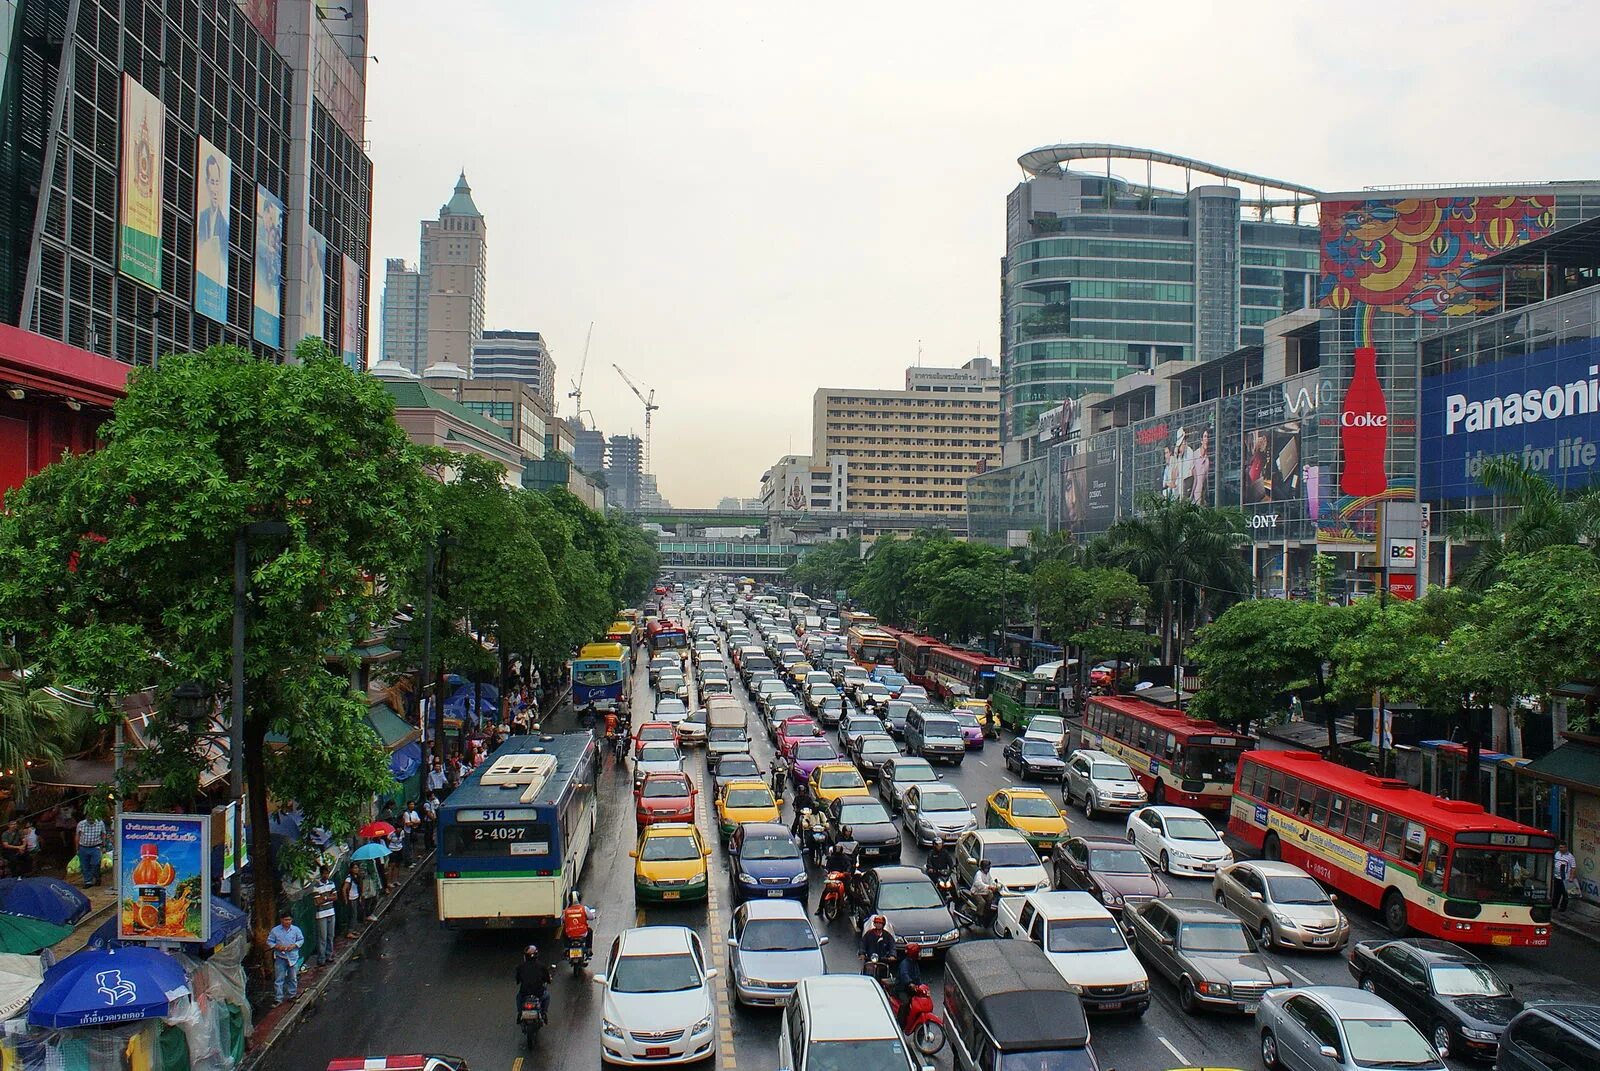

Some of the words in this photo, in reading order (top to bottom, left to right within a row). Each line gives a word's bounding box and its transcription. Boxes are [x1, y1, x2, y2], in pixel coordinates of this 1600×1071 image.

[1285, 380, 1332, 413] VAIO
[1446, 365, 1600, 435] Panasoni
[1341, 411, 1388, 427] Coke
[1522, 444, 1554, 472] for
[1559, 437, 1597, 468] life
[1245, 514, 1278, 529] SONY
[1391, 546, 1414, 558] B2S
[483, 810, 505, 821] 514
[475, 828, 525, 840] 2-4027
[1504, 835, 1516, 845] 13
[1580, 880, 1599, 898] VISA
